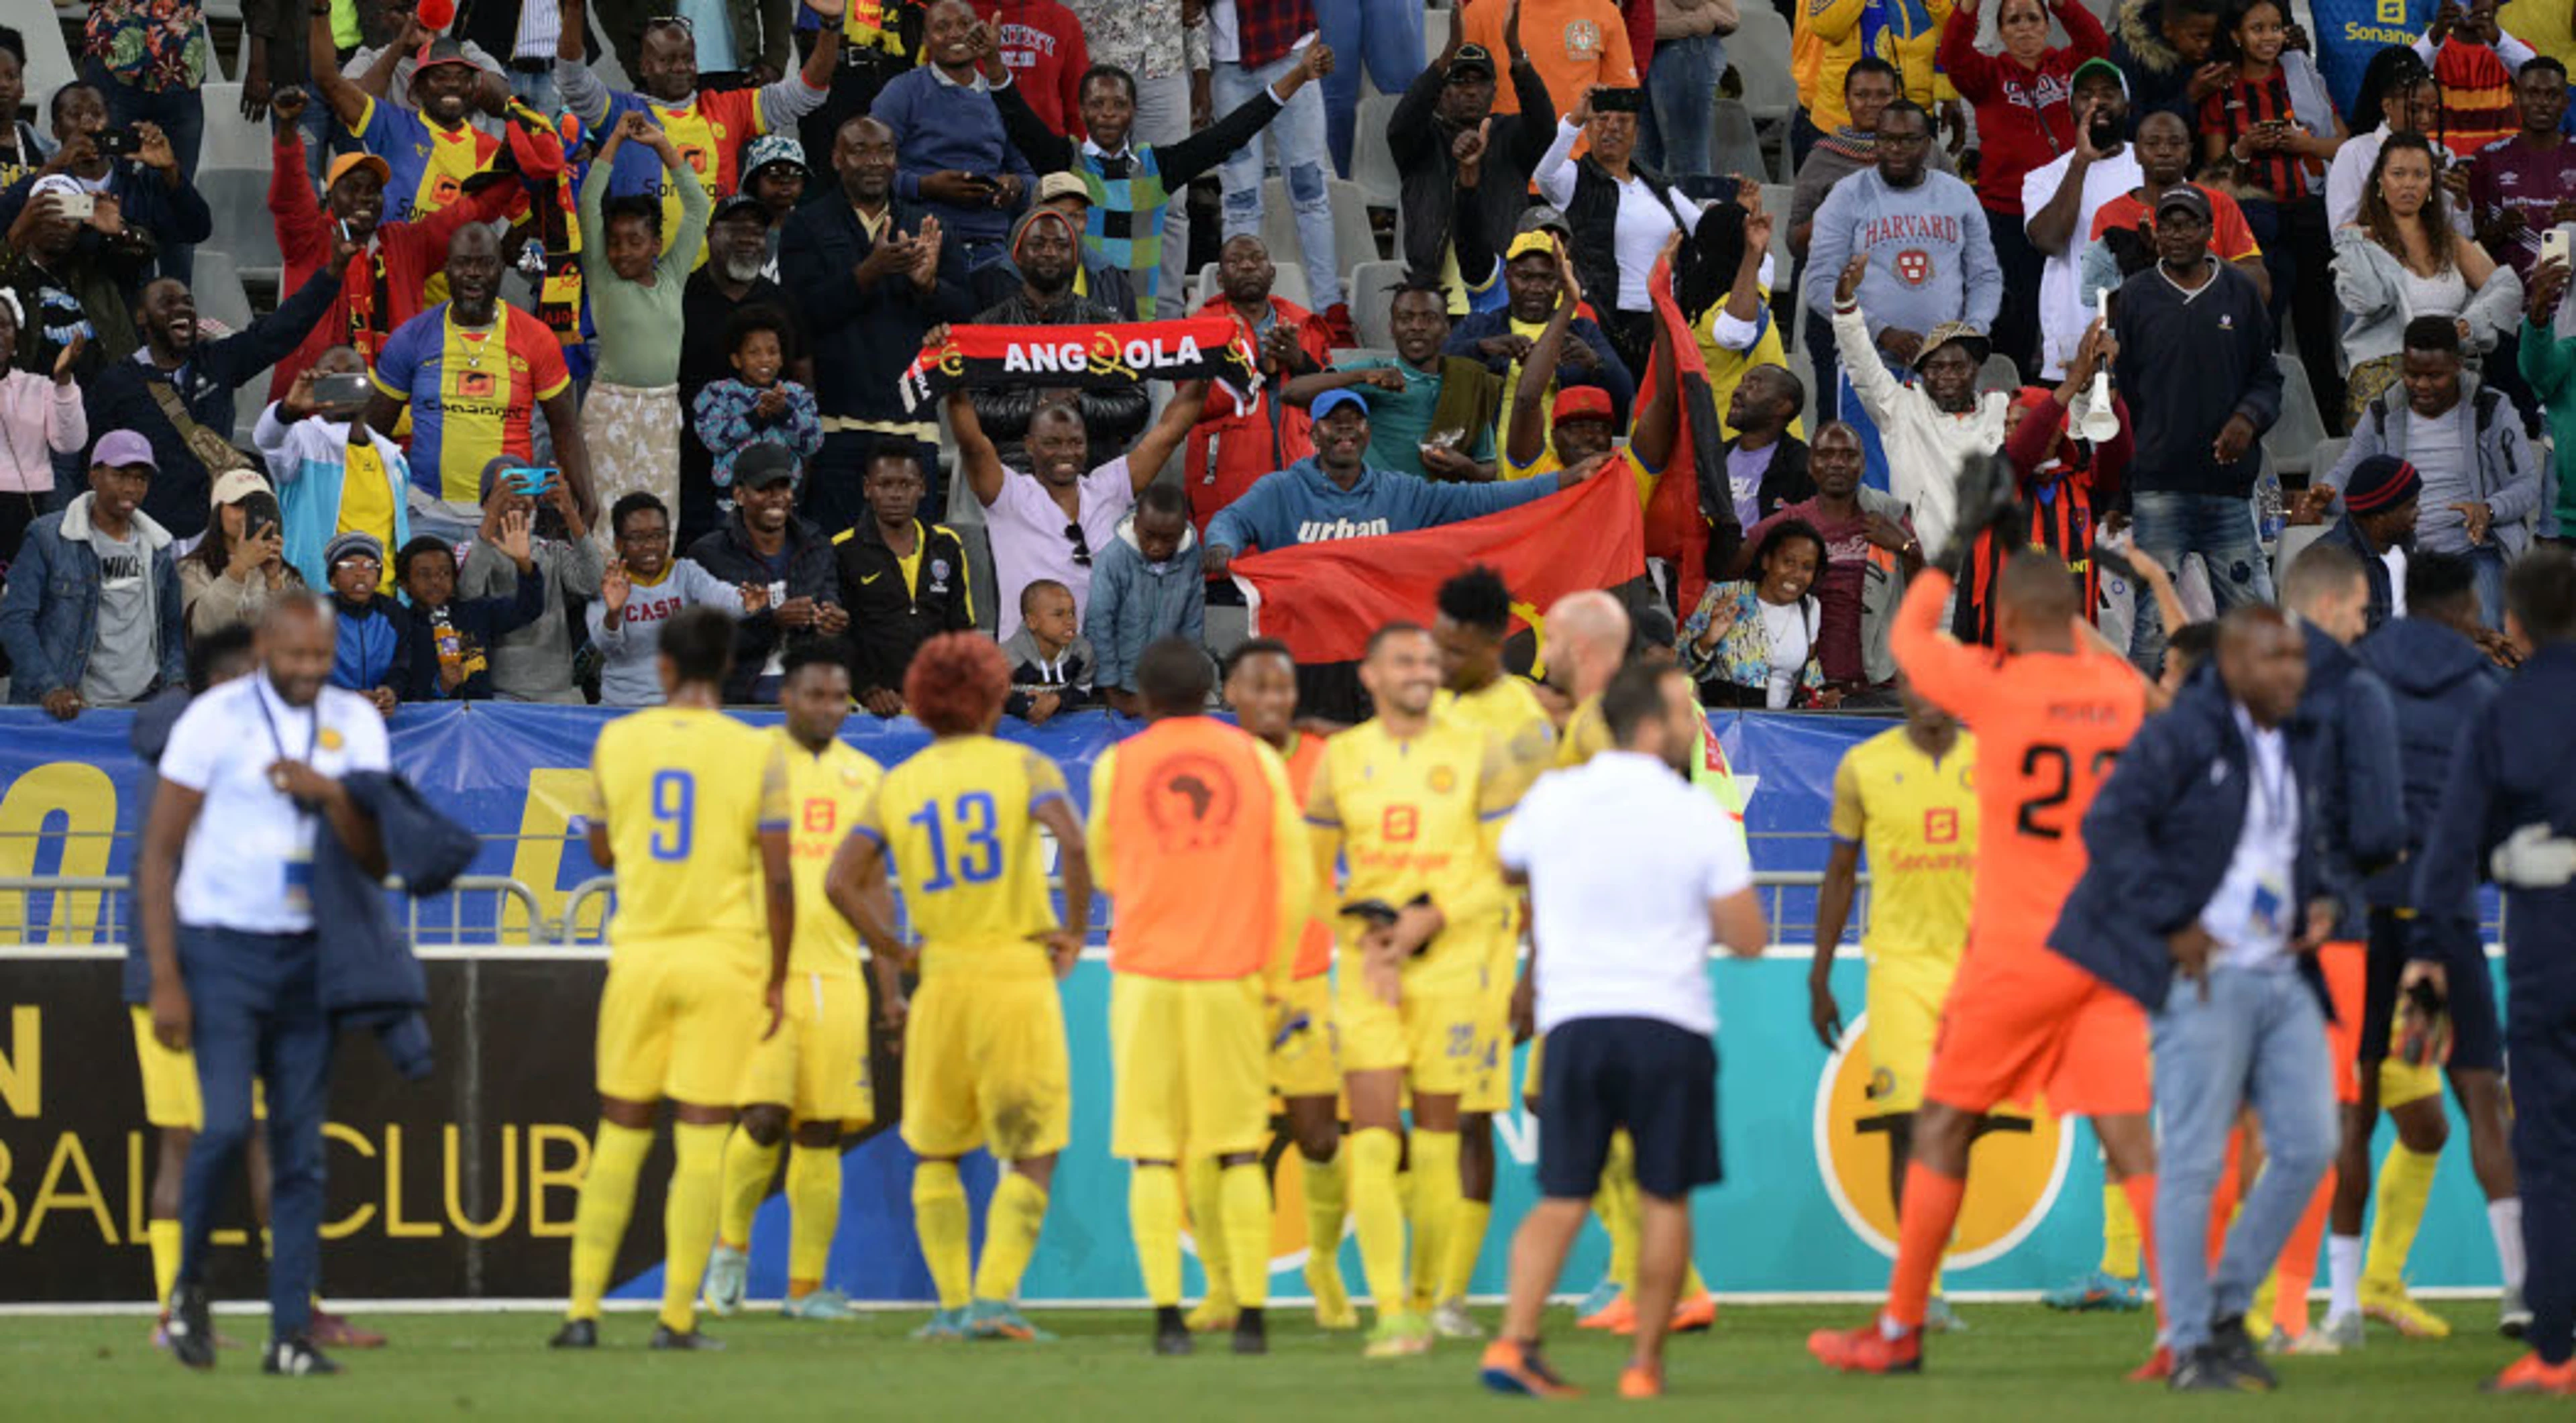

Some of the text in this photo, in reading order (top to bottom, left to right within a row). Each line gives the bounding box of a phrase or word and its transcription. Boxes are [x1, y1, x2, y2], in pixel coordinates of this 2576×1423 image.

[1865, 215, 1957, 248] HARVARD
[650, 769, 696, 863] 9
[908, 790, 1004, 893] 13
[317, 1120, 593, 1240] CLUB
